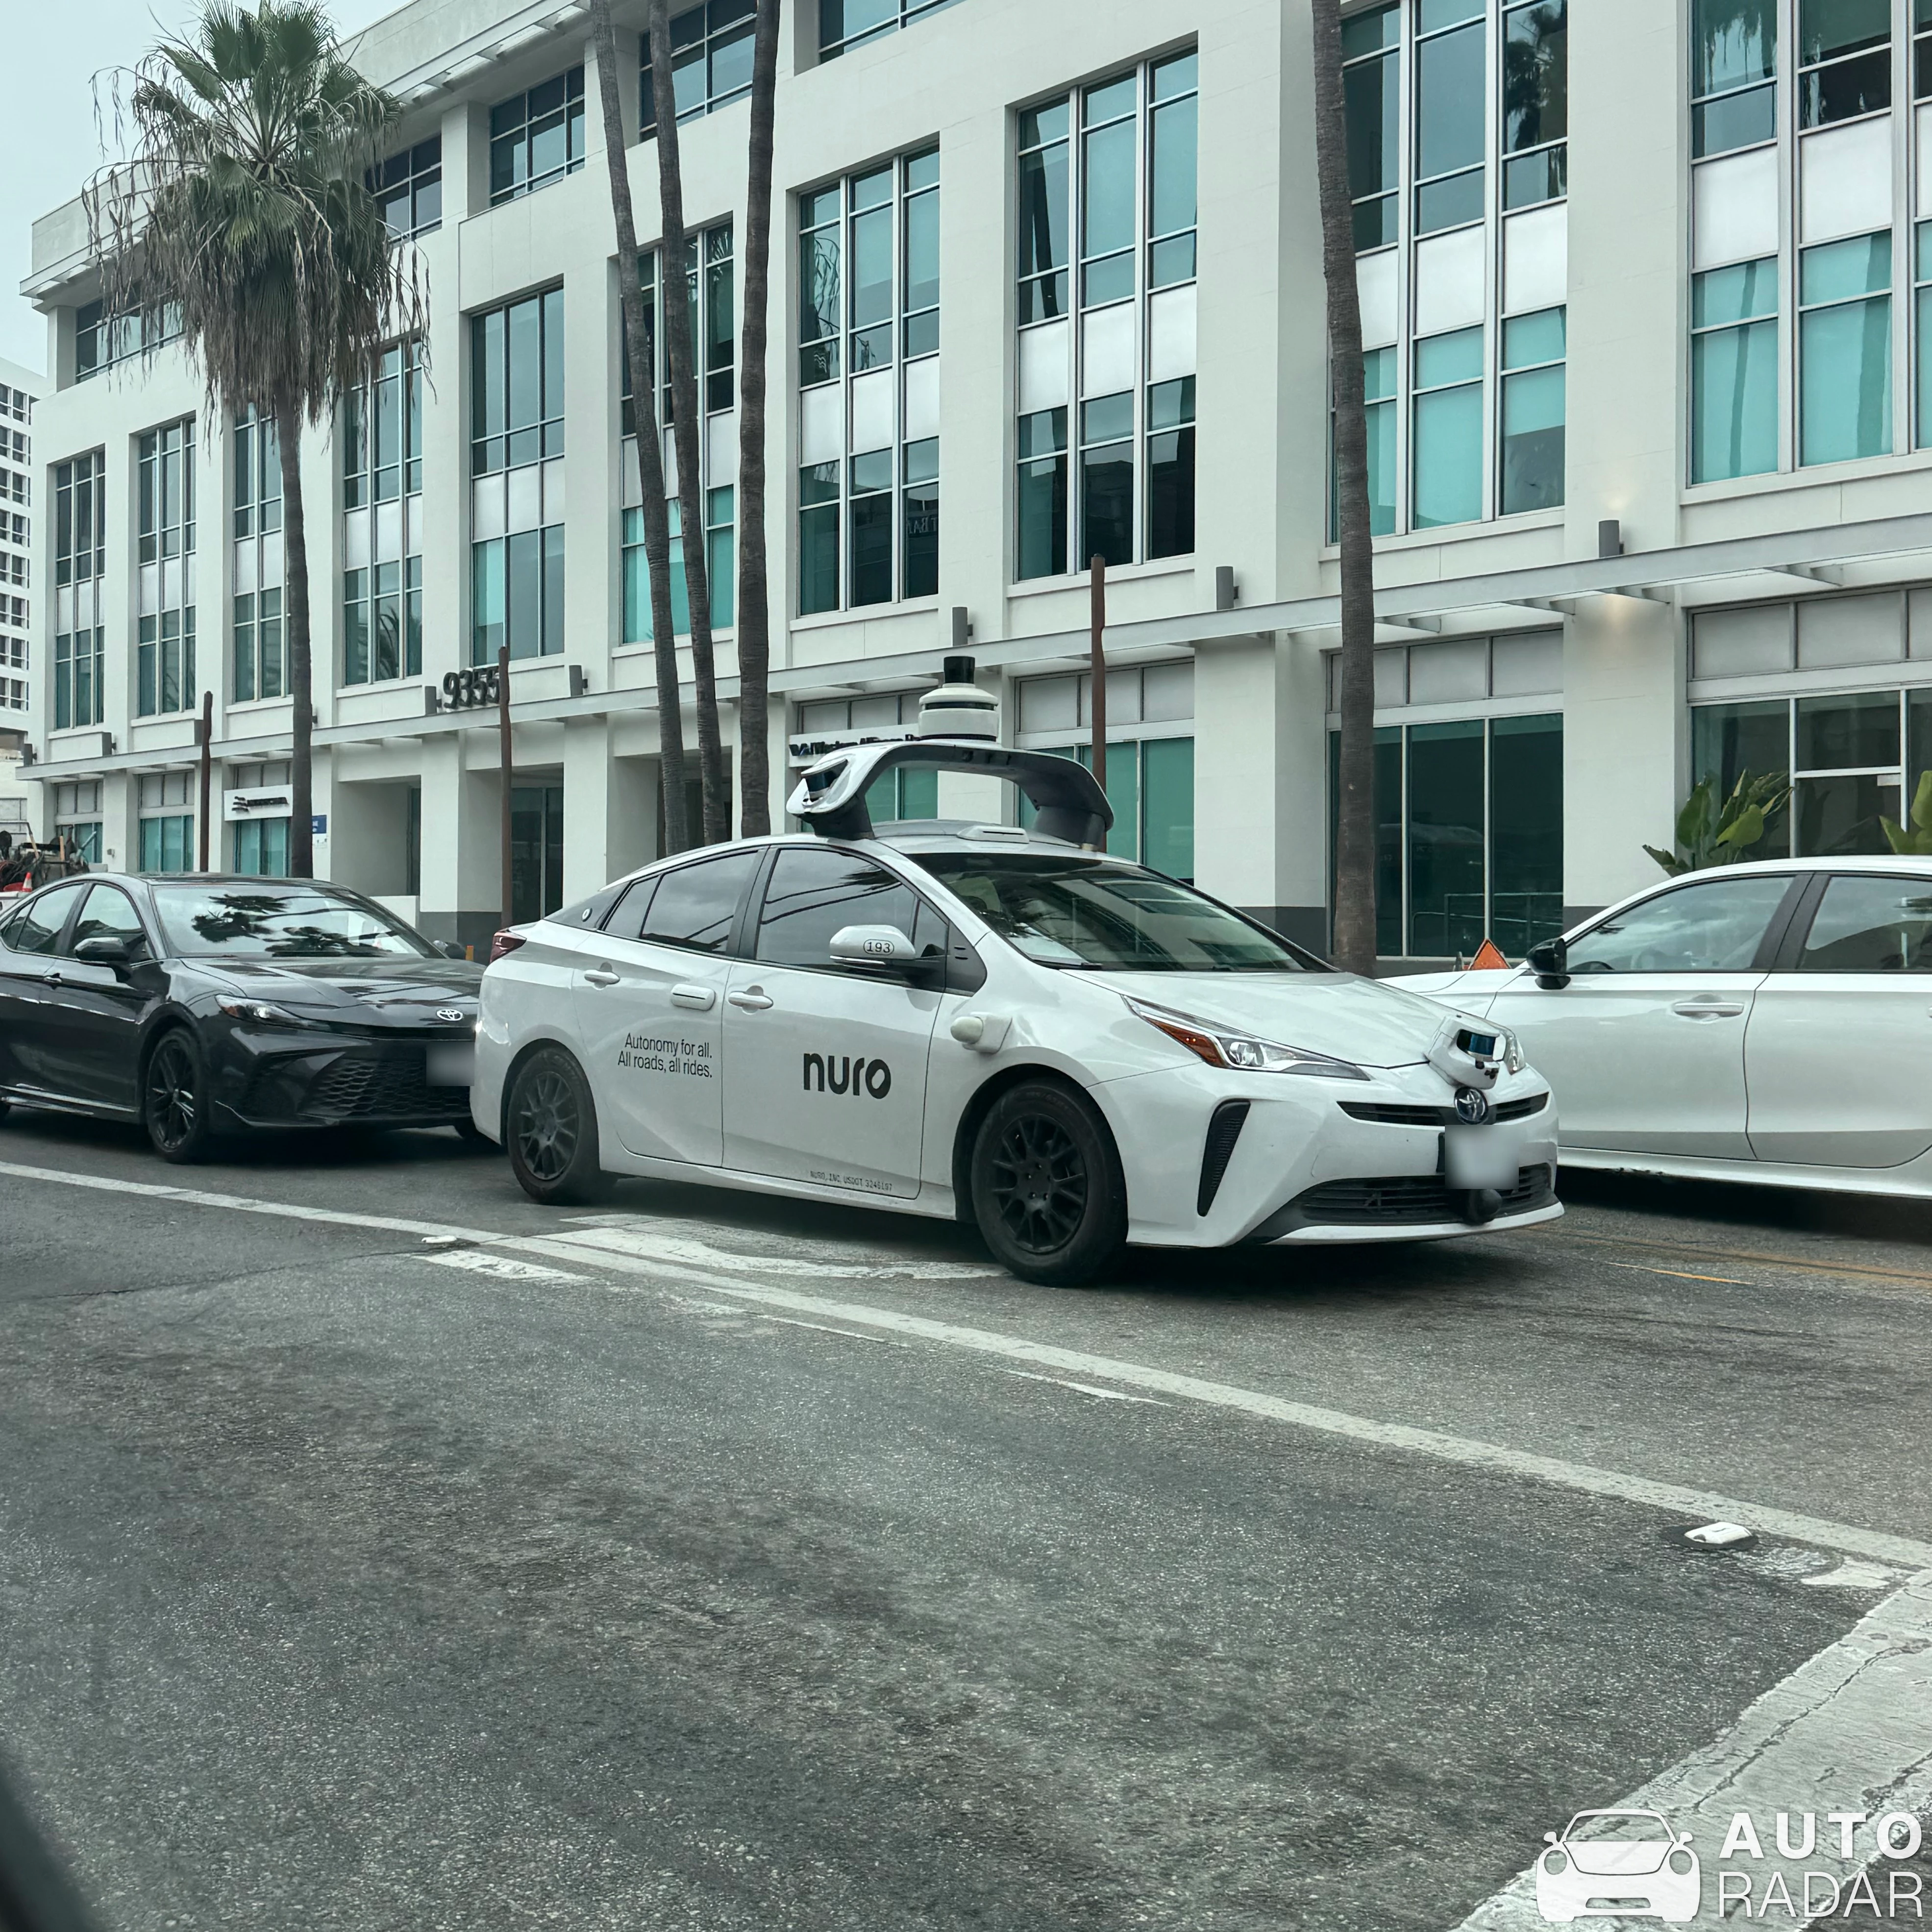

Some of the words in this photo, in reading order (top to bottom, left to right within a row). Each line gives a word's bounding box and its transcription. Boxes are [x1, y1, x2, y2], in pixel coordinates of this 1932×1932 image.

[443, 666, 500, 709] 9355
[867, 941, 891, 953] 193
[624, 1032, 679, 1057] Autonomy
[681, 1039, 695, 1056] for
[697, 1042, 712, 1059] all.
[618, 1050, 631, 1066] All
[634, 1055, 667, 1073] roads,
[669, 1057, 680, 1073] all
[683, 1058, 712, 1078] rides.
[803, 1053, 892, 1099] nuro
[843, 1175, 863, 1187] USDOT
